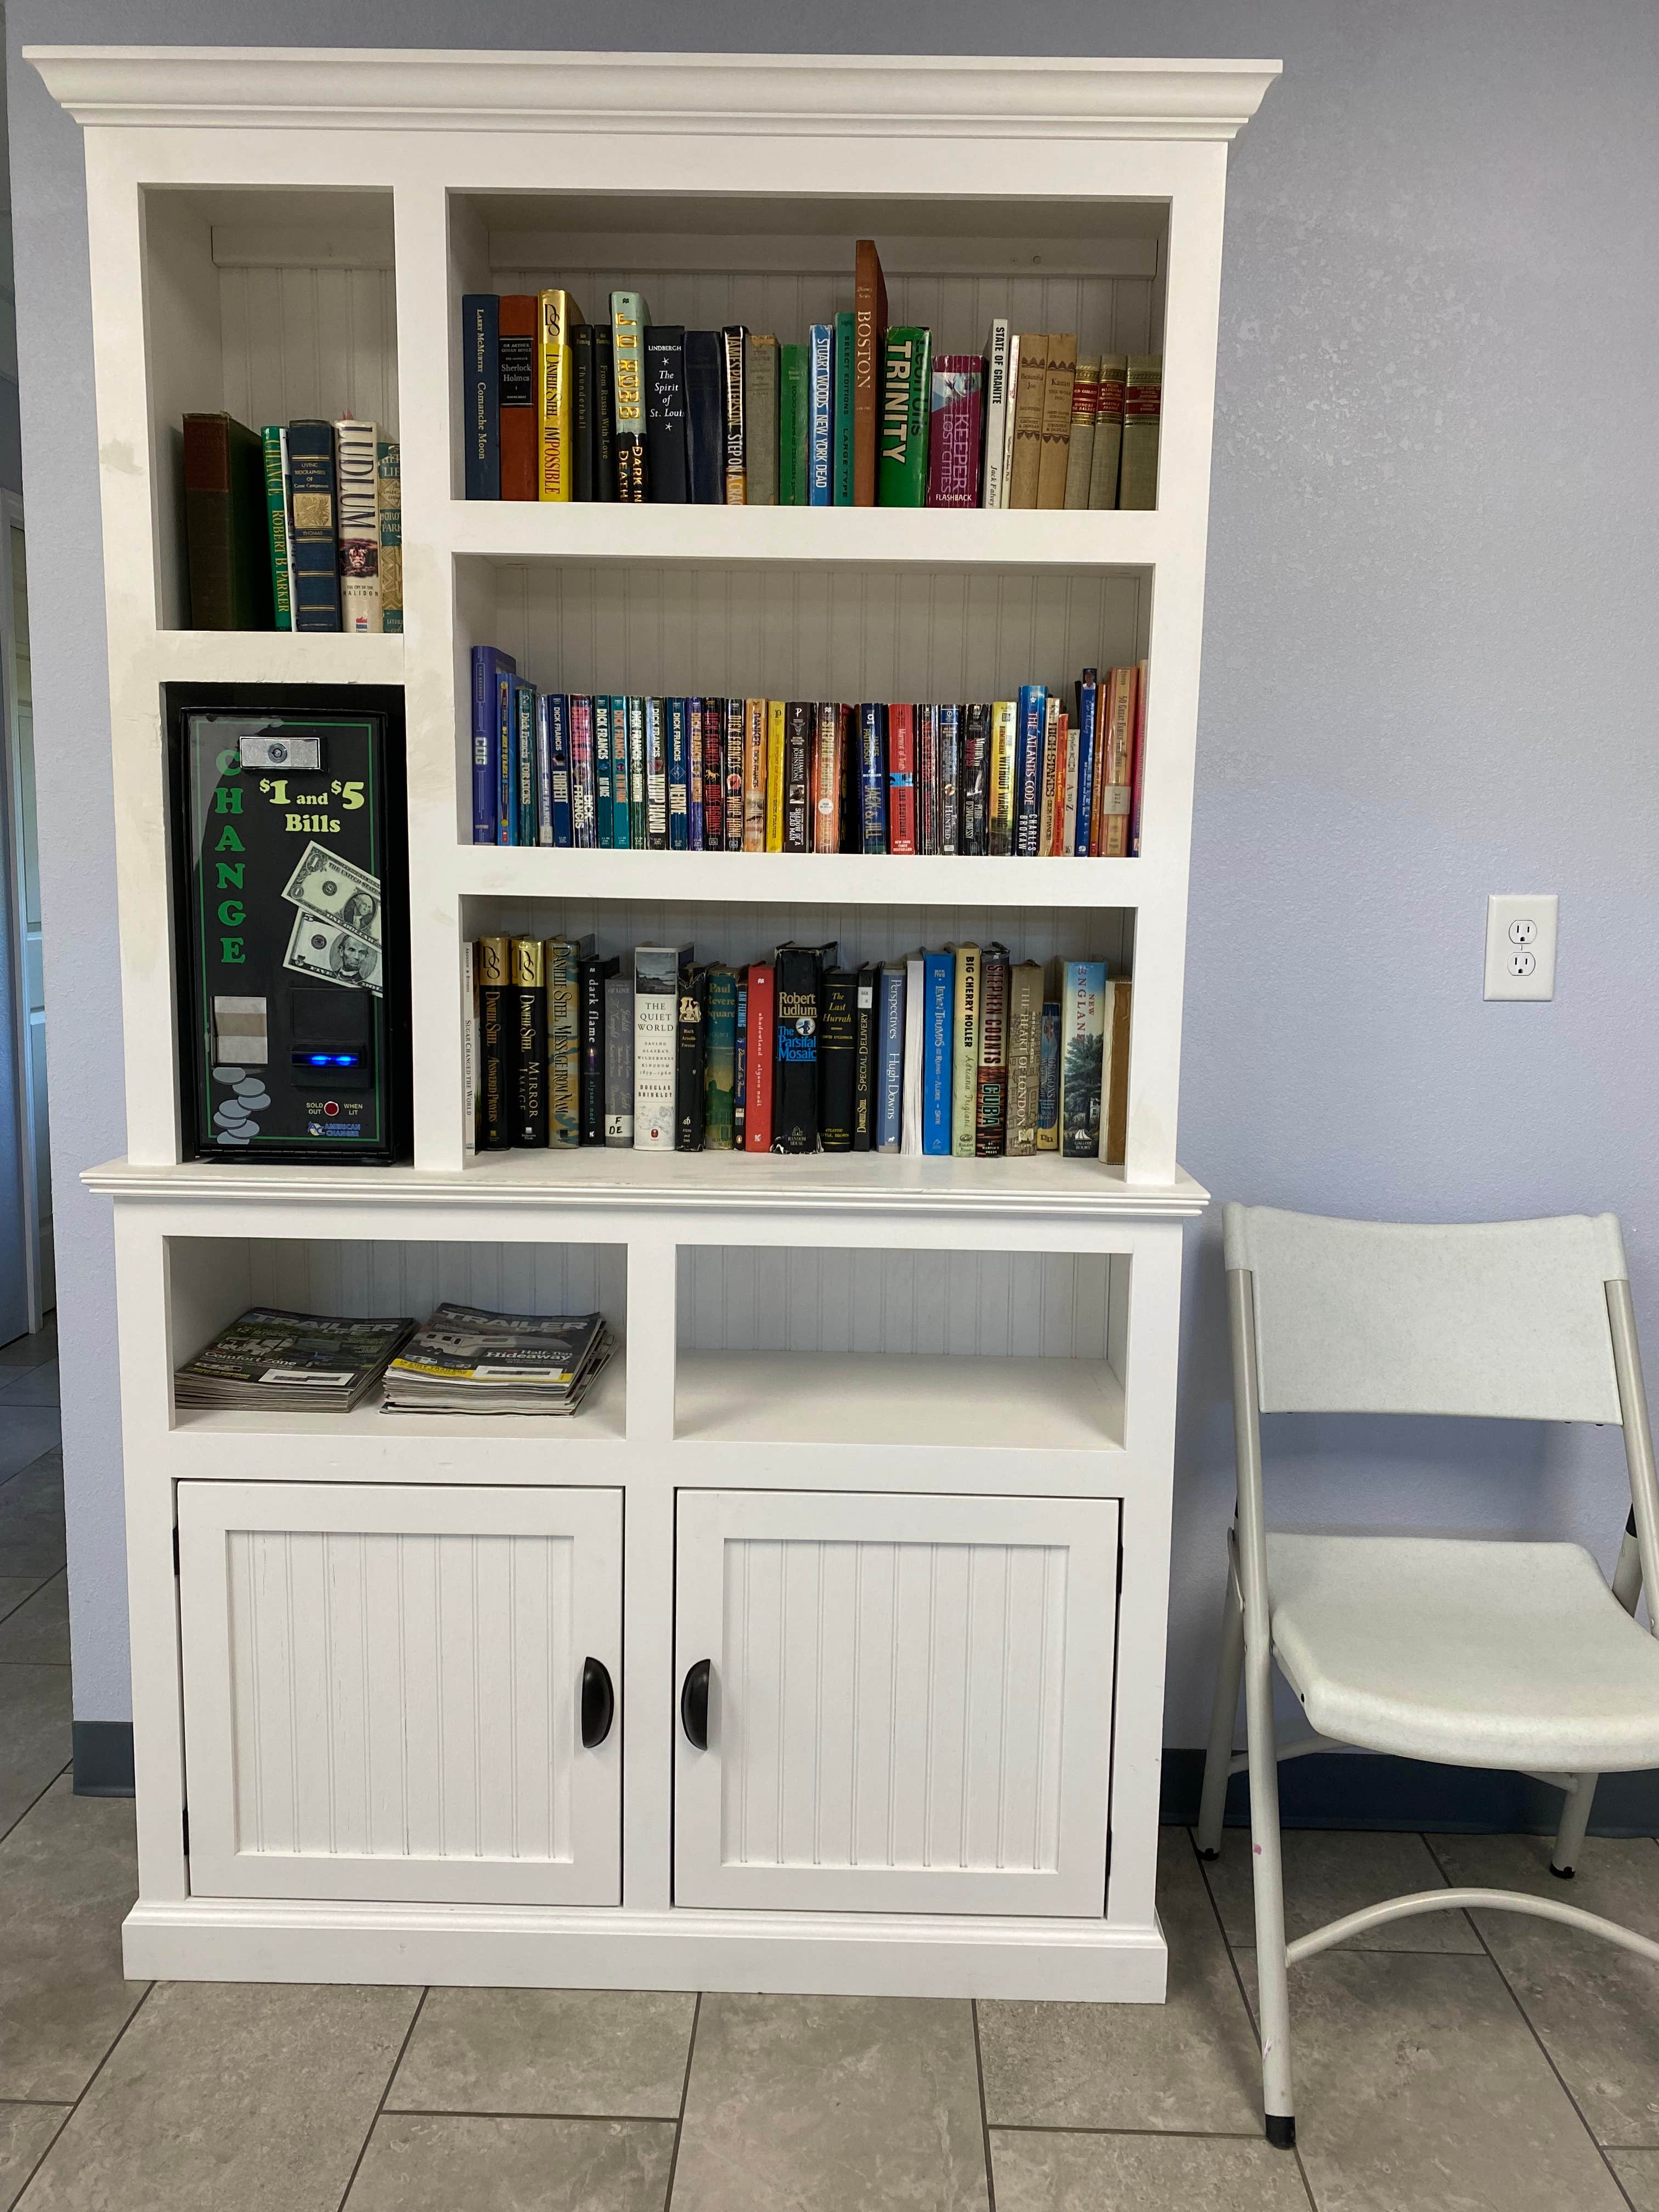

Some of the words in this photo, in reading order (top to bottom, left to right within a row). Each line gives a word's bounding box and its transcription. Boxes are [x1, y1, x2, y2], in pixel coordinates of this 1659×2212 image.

[857, 311, 871, 388] BOSTON
[995, 326, 1005, 352] STATE
[816, 338, 830, 371] STUART
[994, 356, 1003, 366] OF
[654, 382, 679, 394] Spirit
[658, 370, 674, 380] The
[992, 369, 1003, 404] GRANITE
[662, 394, 673, 406] of
[816, 375, 829, 408] WOODS
[882, 340, 912, 464] TRINITY
[477, 382, 486, 431] Comanche
[816, 415, 828, 436] NEW
[478, 432, 487, 460] Moon
[816, 438, 827, 462] YORK
[951, 414, 969, 493] KEEPER
[264, 439, 283, 496] CHANCE
[544, 427, 560, 494] IMPOSSIBLE
[618, 450, 629, 499] DEATH
[632, 445, 643, 486] DARK
[989, 466, 997, 482] Jack
[338, 427, 376, 529] LUDLUM
[815, 464, 827, 488] DEAD
[935, 493, 972, 501] FLASHBACK
[272, 510, 287, 555] ROBERT
[276, 570, 290, 612] PARKER
[521, 712, 530, 729] Dick
[597, 708, 607, 726] DICK
[614, 710, 624, 727] DICK
[631, 710, 641, 727] DICK
[728, 715, 742, 732] DICK
[1028, 712, 1038, 730] THE
[597, 728, 608, 759] FRANCIS
[614, 729, 625, 760] FRANCIS
[632, 730, 642, 760] FRANCIS
[863, 729, 872, 765] PATTERSON
[1047, 722, 1057, 751] HIGH
[475, 737, 487, 765] COG
[727, 736, 741, 769] FRANCIS
[1025, 734, 1037, 777] ATLANTIS
[522, 763, 530, 778] FOR
[998, 756, 1011, 789] WITHOUT
[1046, 754, 1057, 797] STAKES
[259, 777, 291, 805] $1
[296, 793, 328, 805] and
[330, 778, 365, 810] $5
[522, 779, 531, 804] KICKS
[552, 771, 568, 804] FORFEIT
[670, 784, 687, 815] NERVE
[865, 785, 882, 809] JACK
[1024, 781, 1035, 805] CODE
[574, 785, 585, 829] FRANCIS
[584, 795, 594, 819] DICK
[649, 804, 665, 833] HAND
[865, 809, 878, 820] &
[997, 793, 1009, 828] WARNING
[285, 814, 341, 833] Bills
[865, 821, 882, 839] JILL
[944, 805, 953, 839] HUNTED
[1018, 815, 1028, 850] BROKAW
[1028, 814, 1038, 851] CHARLES
[794, 832, 802, 841] OF
[215, 749, 246, 964] CHANGE
[329, 862, 341, 873] THE
[341, 869, 361, 884] UNITED
[552, 946, 571, 989] DANIELLE
[966, 956, 974, 973] BIG
[589, 979, 599, 1005] dark
[709, 983, 731, 994] Paul
[779, 991, 816, 1005] Robert
[832, 992, 844, 1001] The
[965, 976, 974, 1011] CHERRY
[986, 965, 1004, 1014] STEPHEN
[1021, 986, 1030, 1008] THE
[553, 990, 572, 1022] STEEL
[640, 1013, 672, 1022] QUIET
[738, 1003, 747, 1028] FLEMING
[778, 1004, 817, 1018] Ludlum
[823, 1013, 851, 1023] Hurrah
[828, 1002, 846, 1011] Last
[889, 979, 902, 1040] Perspectives
[589, 1010, 599, 1043] flame
[637, 1024, 674, 1032] WORLD
[778, 1026, 794, 1036] The
[859, 1012, 869, 1054] DELIVERY
[935, 1010, 945, 1046] THUMPS
[964, 1014, 973, 1047] HOLLER
[1019, 1013, 1029, 1052] HEART
[554, 1025, 572, 1068] MESSAGE
[777, 1047, 817, 1061] Mosaic
[778, 1035, 816, 1048] Parsifal
[984, 1019, 1002, 1064] COONTS
[857, 1056, 868, 1092] SPECIAL
[887, 1053, 900, 1082] Hugh
[1018, 1056, 1028, 1071] OF
[528, 1062, 540, 1119] MIRROR
[554, 1069, 569, 1092] FROM
[554, 1092, 573, 1114] NAM
[887, 1084, 900, 1119] Downs
[981, 1084, 1001, 1126] CUBA
[1016, 1075, 1028, 1126] LONDON
[609, 1125, 623, 1135] DE
[614, 1116, 623, 1125] F
[253, 1313, 400, 1333] TRAILER
[441, 1310, 589, 1330] TRAILER
[204, 1351, 263, 1362] Comfort
[261, 1358, 298, 1366] Zone
[485, 1351, 574, 1361] Hideaway
